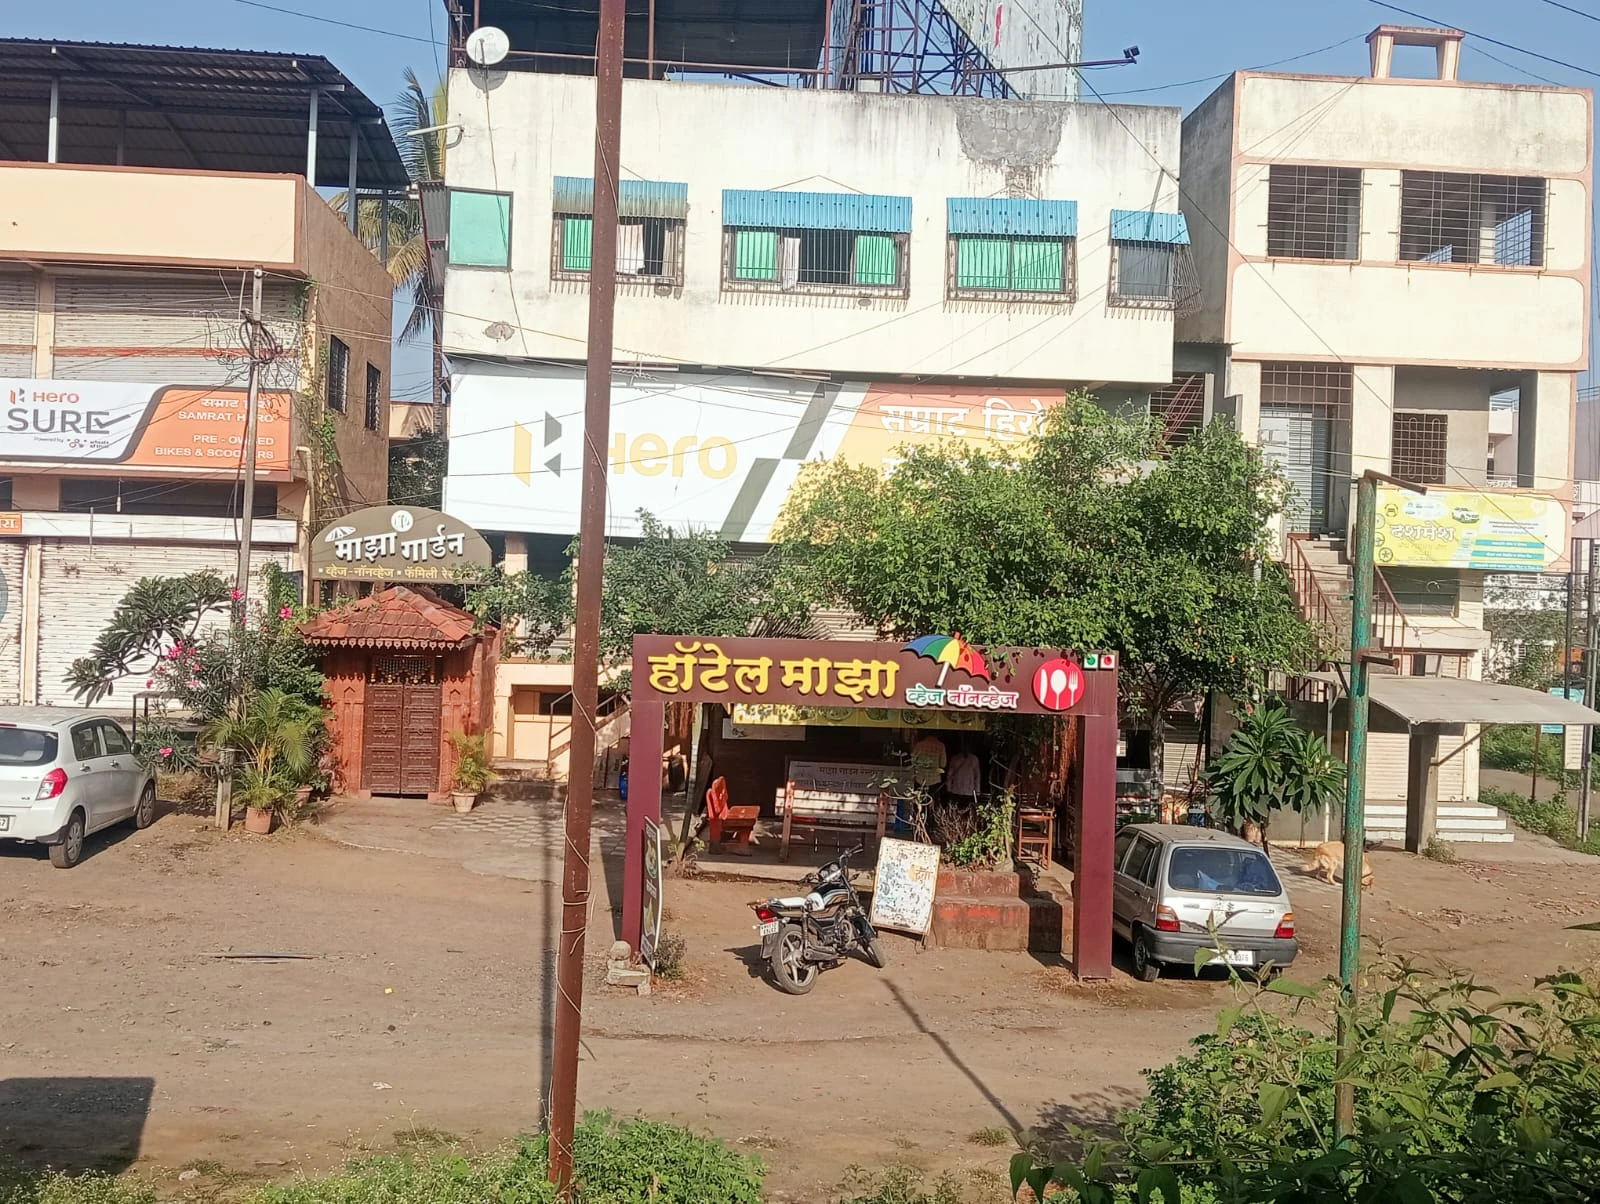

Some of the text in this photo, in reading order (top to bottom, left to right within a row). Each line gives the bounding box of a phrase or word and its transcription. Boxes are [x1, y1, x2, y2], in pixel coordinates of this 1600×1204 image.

[33, 391, 80, 404] Hero
[178, 411, 274, 423] SAMRAT HRO
[879, 404, 969, 436] सम्राट
[193, 434, 218, 444] PRE
[228, 436, 275, 446] OWED
[155, 447, 191, 457] BIKES
[195, 448, 203, 457] &
[335, 524, 466, 562] माझा गार्डन
[1390, 520, 1455, 543] दशमेश
[648, 641, 900, 703] हॉटेल माझा
[905, 683, 1020, 710] व्हेज नॉनव्हेज
